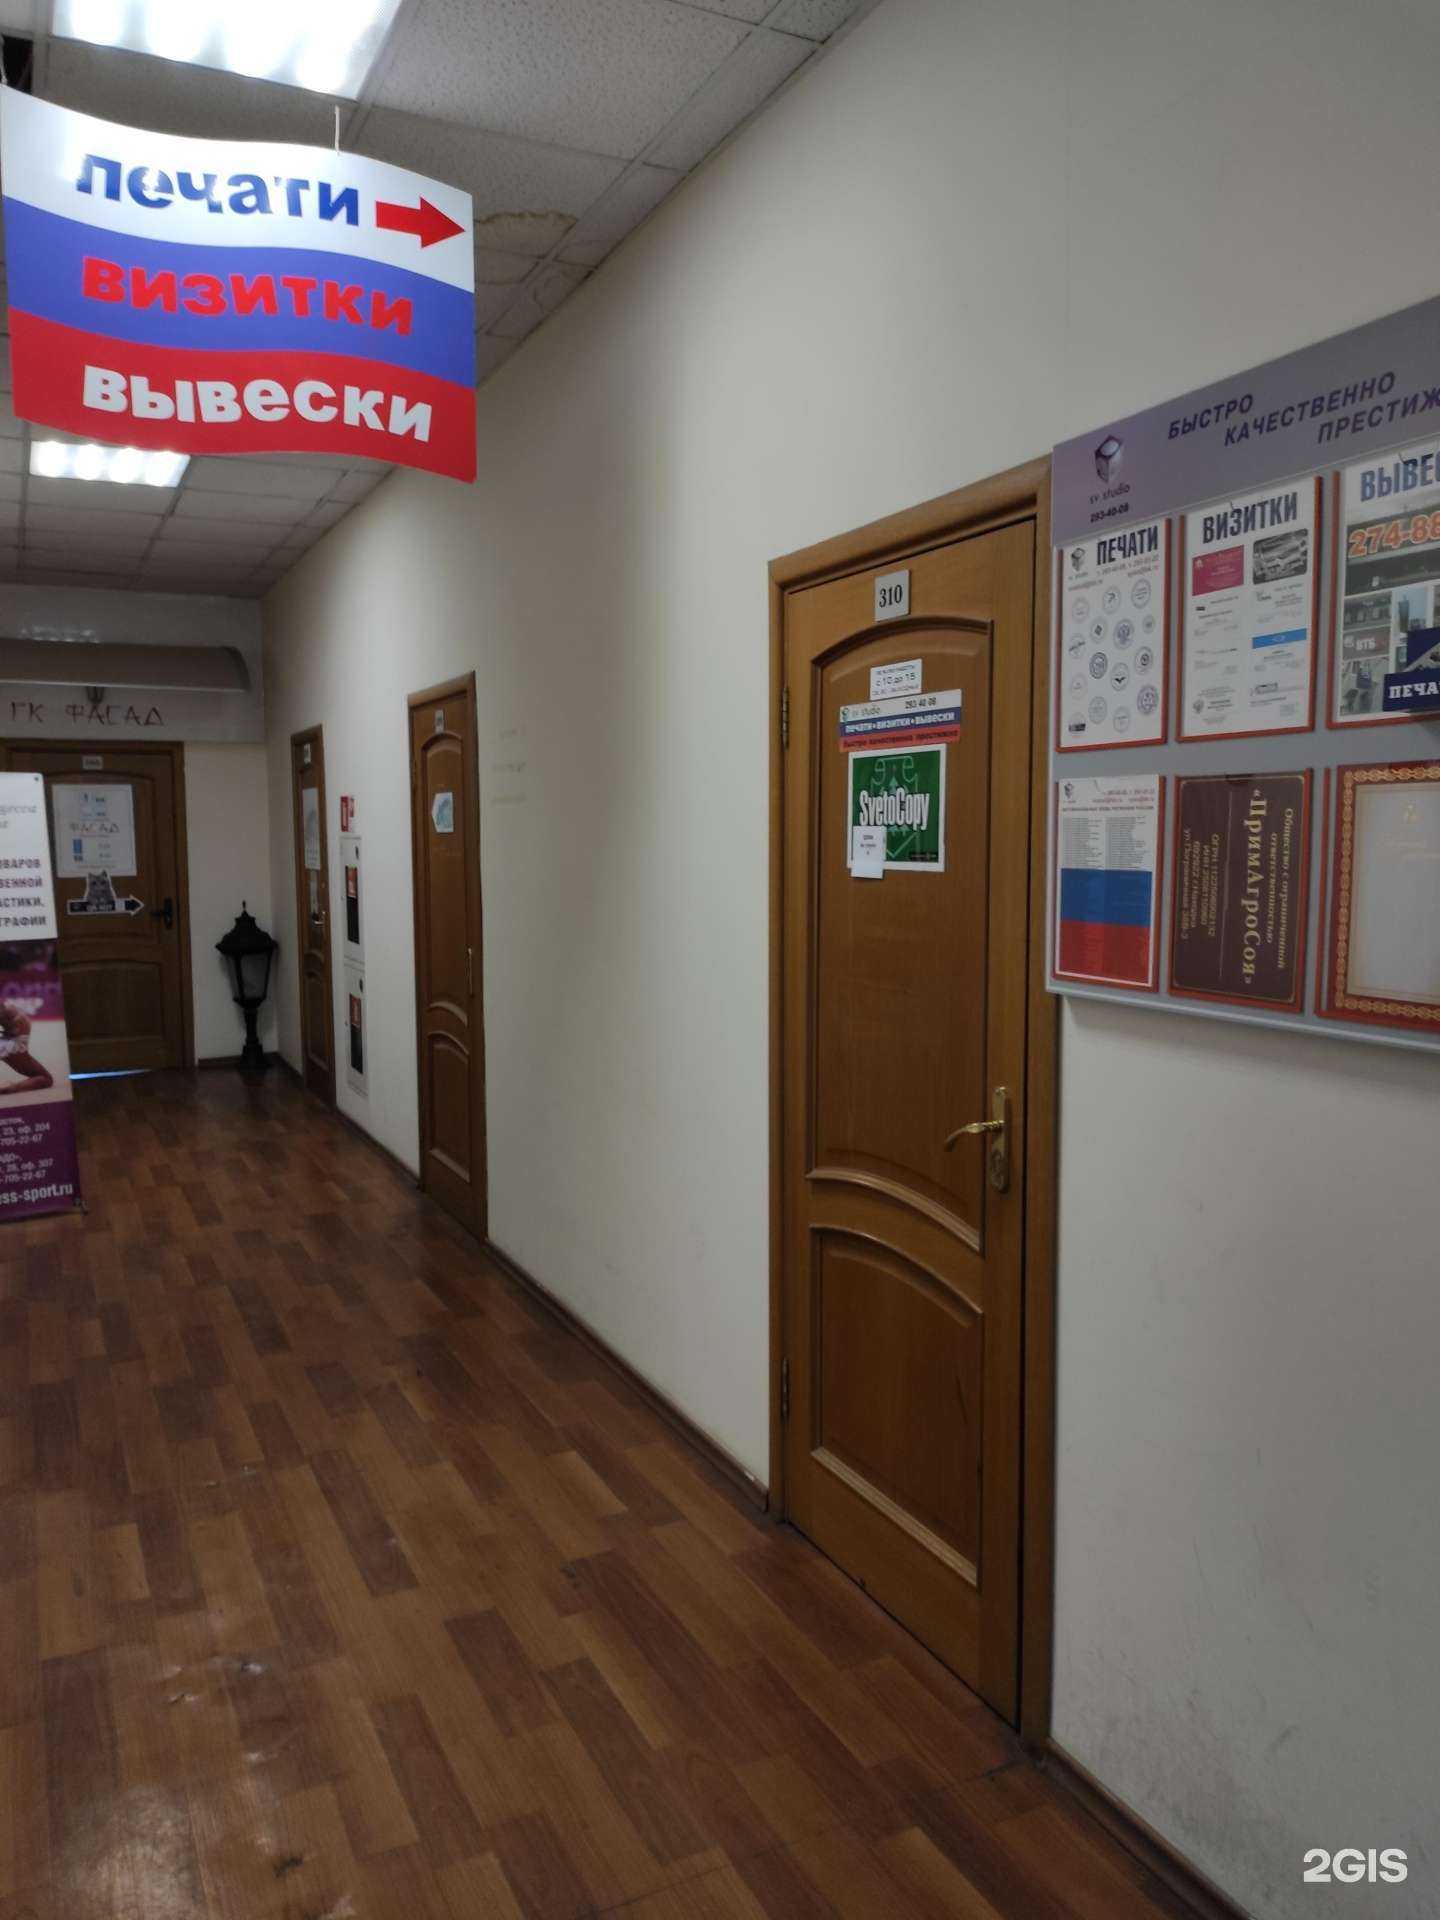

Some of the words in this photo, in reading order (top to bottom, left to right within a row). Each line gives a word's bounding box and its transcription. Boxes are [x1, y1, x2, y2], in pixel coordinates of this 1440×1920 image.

[76, 153, 359, 226] печати
[82, 256, 413, 335] визитки
[83, 364, 432, 442] вывески
[1168, 394, 1254, 440] БЫСТРО
[1224, 371, 1396, 447] КАЧЕСТВЕННО
[1203, 492, 1298, 544] ВИЗИТКИ
[1096, 525, 1158, 566] ПЕЧАТИ
[878, 584, 903, 608] 310
[1388, 681, 1440, 699] ПЕЧА
[10, 702, 45, 724] ГК
[65, 703, 164, 726] ФАСАД
[859, 787, 930, 831] SvetoCopy
[0, 858, 41, 869] ВАРОВ
